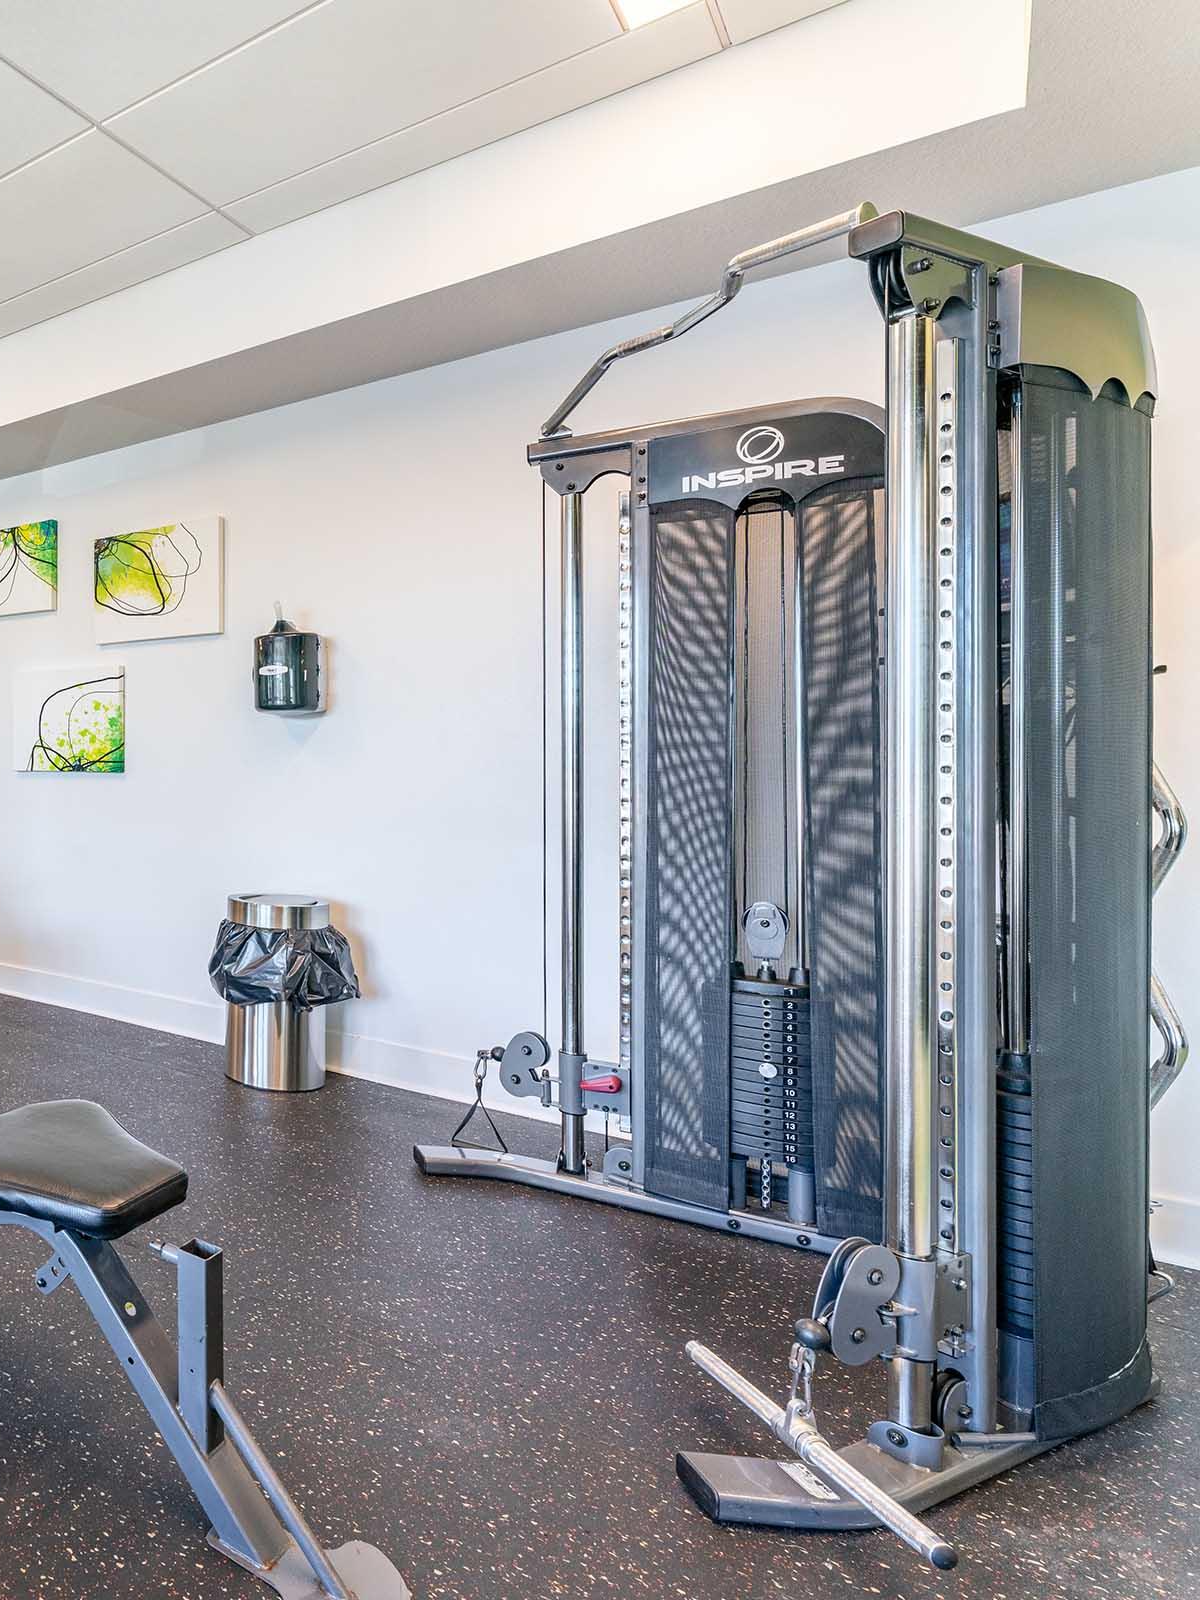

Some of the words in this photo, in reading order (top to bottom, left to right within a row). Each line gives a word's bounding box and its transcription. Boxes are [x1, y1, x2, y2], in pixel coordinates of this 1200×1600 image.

[682, 455, 845, 493] INSPIRE
[784, 1089, 795, 1097] 10
[786, 1100, 796, 1108] 11
[784, 1111, 795, 1119] 12
[785, 1122, 796, 1130] 13
[785, 1133, 796, 1141] 14
[784, 1144, 796, 1152] 15
[785, 1155, 796, 1163] 16
